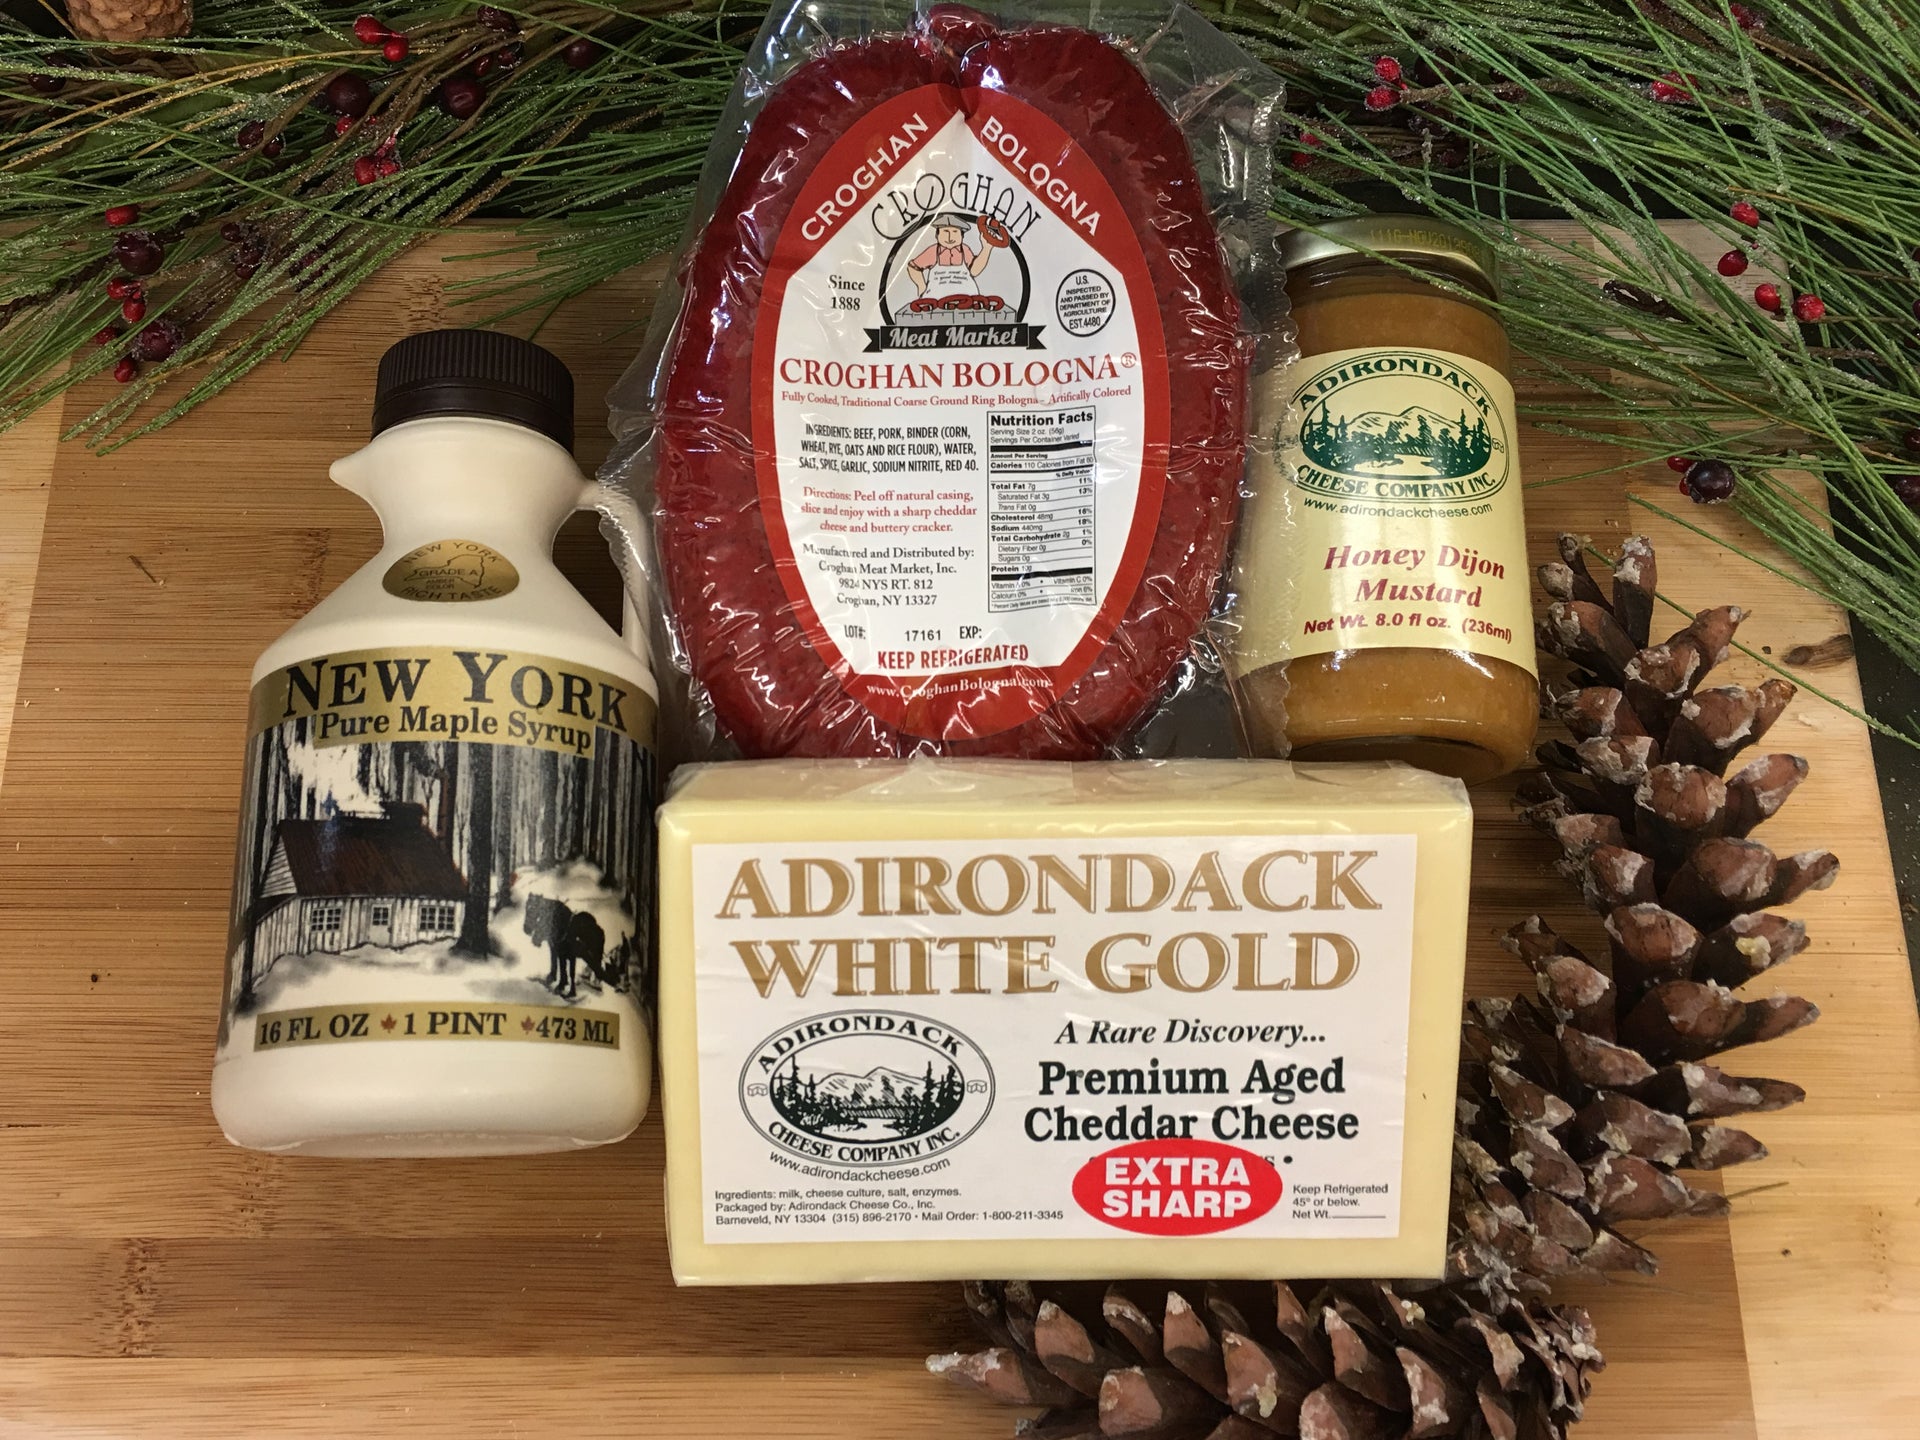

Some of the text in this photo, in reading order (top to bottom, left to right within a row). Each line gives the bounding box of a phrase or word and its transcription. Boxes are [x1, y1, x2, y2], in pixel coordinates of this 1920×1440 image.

[801, 112, 929, 241] CROGHAN
[981, 116, 1101, 236] BOLOGNA
[872, 172, 1042, 242] CROGHAN
[828, 274, 865, 291] Since
[1076, 275, 1089, 285] U.S.
[1066, 286, 1101, 294] INSPECTED
[1074, 293, 1098, 302] PASSED
[830, 297, 861, 311] 1888
[1060, 301, 1100, 310] DEPARTMENT
[1064, 307, 1107, 317] AGRICULTURE
[889, 325, 1018, 347] Meat Market
[780, 358, 944, 389] CROGHAN
[782, 391, 807, 404] Fully
[808, 393, 839, 407] Cooked,
[841, 396, 891, 407] Traditional
[894, 397, 927, 406] Coarse
[930, 396, 968, 405] Ground
[972, 395, 995, 407] Ring
[999, 395, 1038, 408] Bologna
[1093, 385, 1131, 398] Colored
[1300, 358, 1491, 417] ADIRONDACK
[990, 411, 1093, 426] Nutrition Facts
[854, 426, 970, 440] BEEF, PORK, BINDER (CORN,
[845, 443, 976, 456] OATS AND RICE FLOUR), WATER,
[841, 460, 979, 473] GARLIC, SODIUM NITRITE, RED 40.
[1297, 464, 1496, 498] CHEESE COMPANY INC.
[803, 487, 973, 502] Directions: Peel off natural casing,
[801, 503, 977, 520] slice and enjoy with sharp cheddar
[1303, 498, 1492, 518] www.adirondackcheese.com
[820, 520, 952, 535] cheese and buttery cracker.
[1013, 533, 1060, 542] Carbohydrate
[404, 542, 502, 563] NEW YORK
[870, 547, 974, 560] and Distributed by:
[859, 562, 957, 575] Meat Market, Inc.
[1323, 545, 1505, 579] Honey Dijon
[401, 586, 501, 600] RICH TASTE
[862, 579, 933, 590] NYS RT. 812
[1354, 579, 1482, 607] Mustard
[882, 594, 937, 605] NY 13327
[904, 626, 982, 641] 17161 EXP:
[1304, 618, 1334, 634] Net
[1376, 613, 1403, 626] 8.0
[1410, 614, 1422, 626] fl
[1426, 617, 1451, 629] oz.
[1461, 618, 1512, 644] (236ml)
[878, 645, 1029, 669] KEEP REFRIGERATED
[283, 651, 627, 732] NEW YORK
[320, 706, 591, 753] Pure Maple Syrup
[715, 850, 1382, 920] ADIRONDACK
[730, 932, 1360, 999] WHITE GOLD
[260, 1011, 614, 1044] 16 FL OZ 1 PINT 473 ML
[1054, 1018, 1326, 1048] A Rare Discovery...
[758, 1015, 964, 1074] ADIRONDACK
[1039, 1056, 1346, 1104] Premium Aged
[1024, 1105, 1359, 1141] Cheddar Cheese
[768, 1121, 961, 1162] CHEESE COMPANY INC.
[769, 1151, 950, 1181] www.adirondackcheese.com
[1105, 1157, 1250, 1185] EXTRA
[715, 1187, 962, 1201] Ingredients: milk, cheese culture, salt, enzymes.
[1293, 1184, 1388, 1196] Keep Refrigerated
[715, 1199, 935, 1214] Packaged by: Adirondack Cheese Co., Inc.
[1102, 1190, 1251, 1219] SHARP
[1293, 1198, 1310, 1206] 45°
[1328, 1198, 1360, 1206] below.
[716, 1210, 1064, 1226] Barneveld, NY 13304 (315) 896-2170 Mail Order: 1-800-211-3345
[1292, 1210, 1310, 1218] Net
